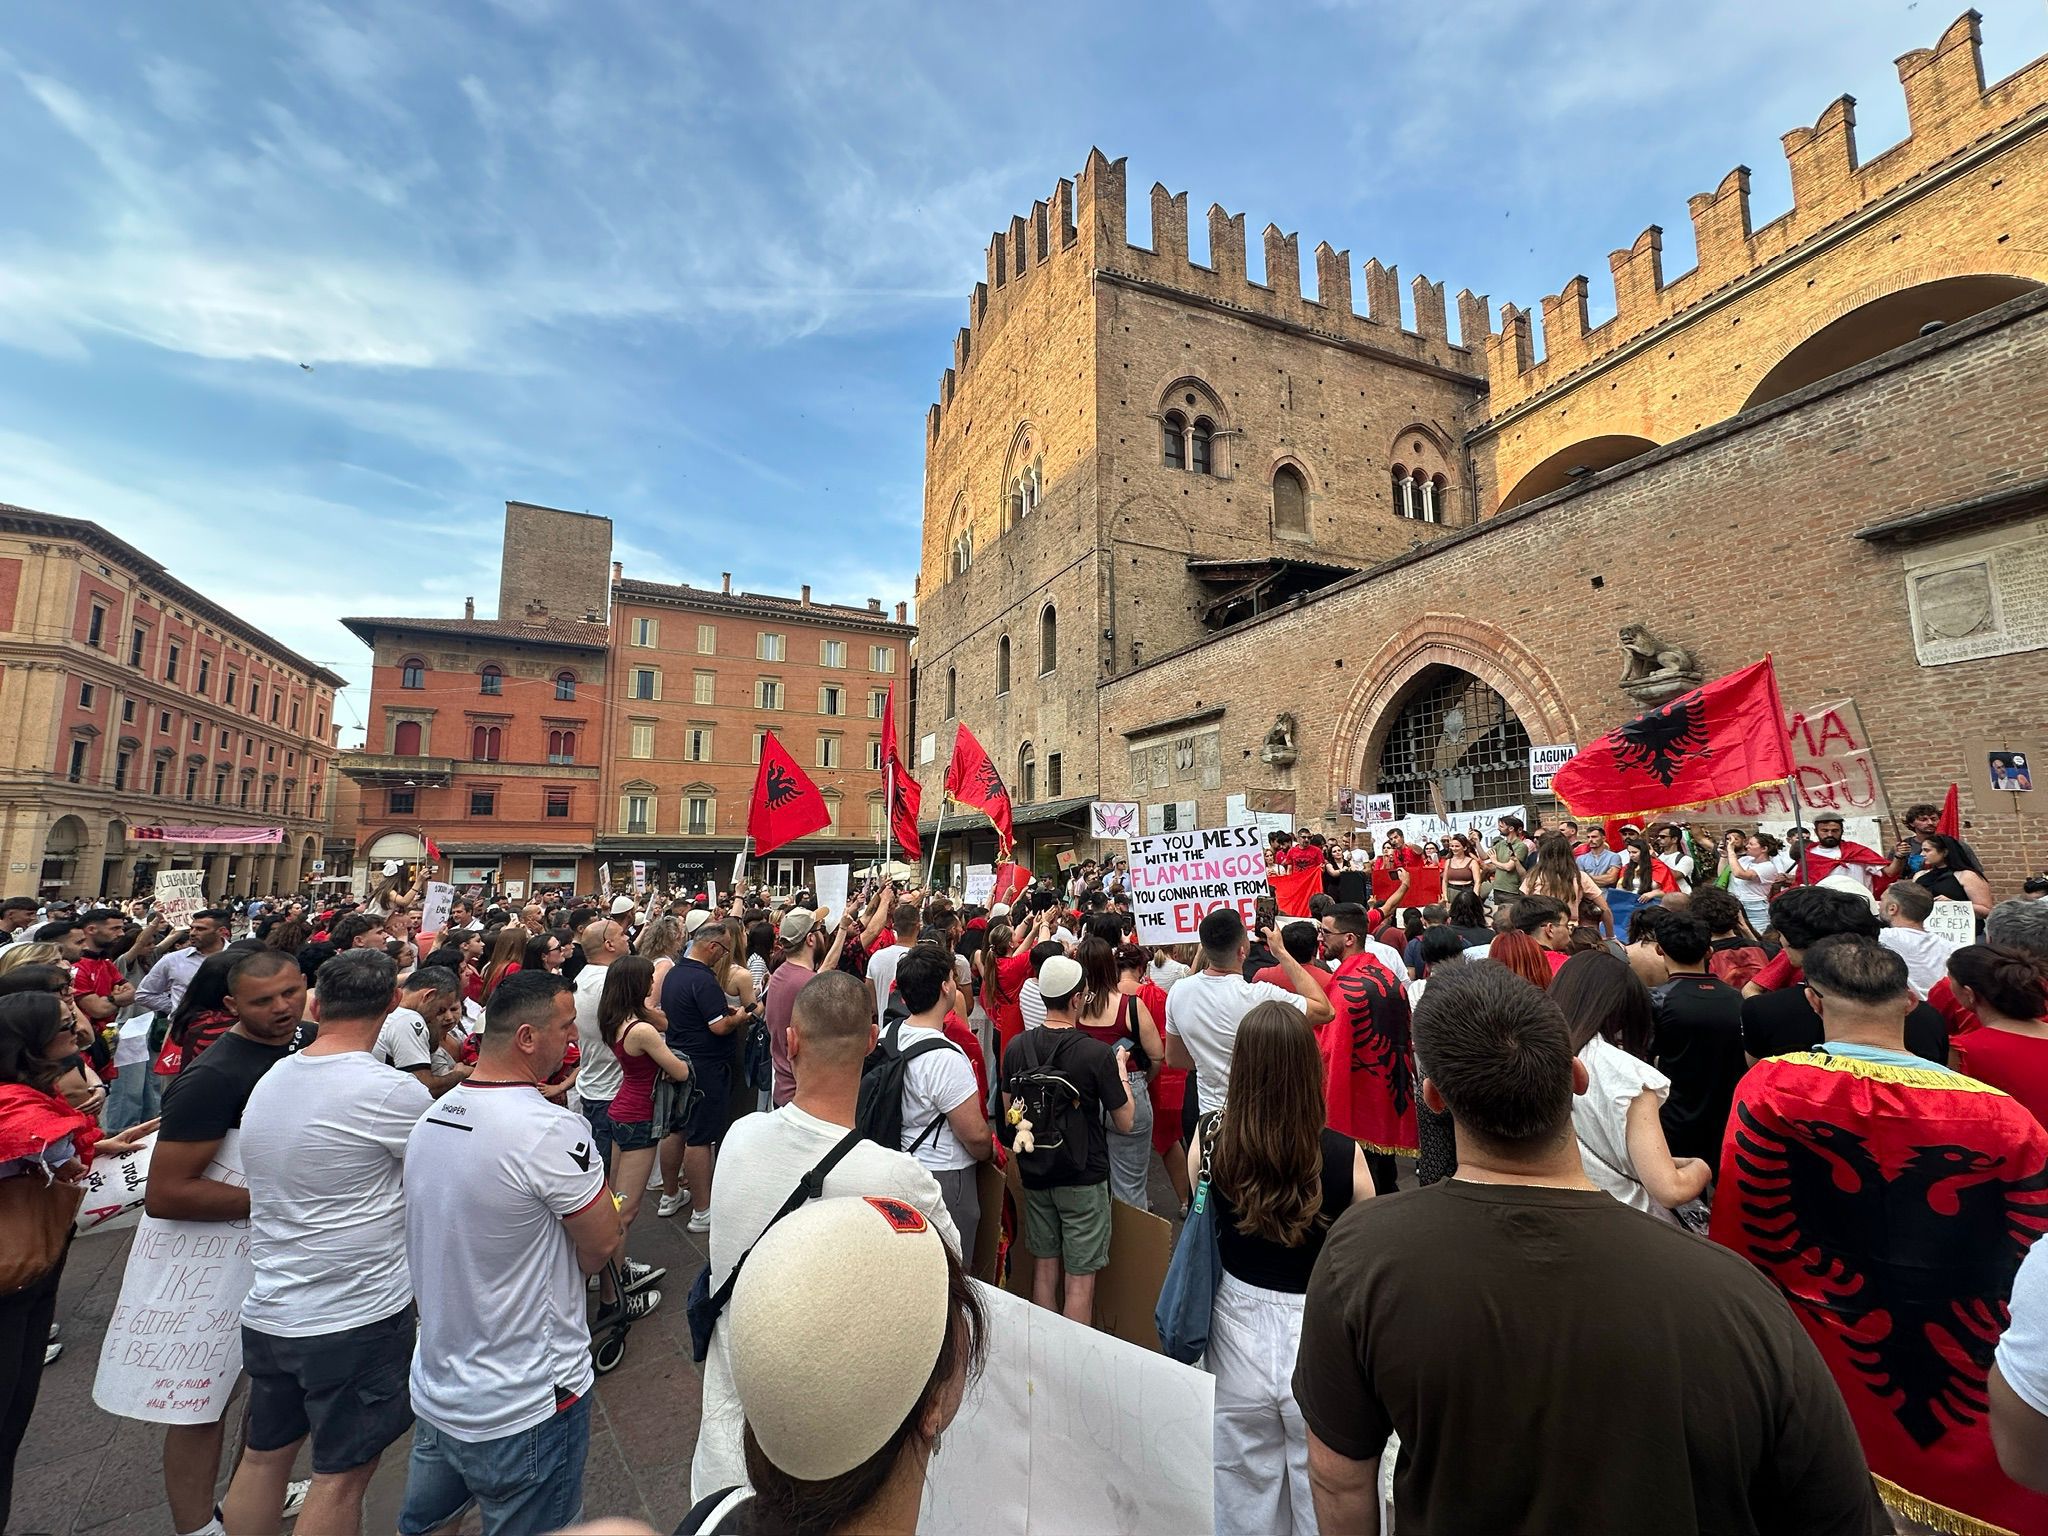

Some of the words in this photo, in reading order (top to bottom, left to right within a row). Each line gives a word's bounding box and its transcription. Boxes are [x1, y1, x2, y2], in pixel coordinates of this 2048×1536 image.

[1534, 749, 1574, 763] LAGUNA
[1131, 840, 1153, 854] IF
[1163, 835, 1193, 851] YOU
[1202, 827, 1259, 850] MESS
[1145, 852, 1179, 865] WITH
[1182, 849, 1205, 861] THE
[1131, 853, 1266, 887] FLAMINGOS
[1134, 890, 1156, 904] YOU
[1158, 886, 1198, 901] GONNA
[1200, 883, 1231, 898] HEAR
[1234, 879, 1269, 895] FROM
[1139, 912, 1166, 927] THE
[1952, 904, 1970, 916] PAR
[135, 1227, 171, 1260] IKE
[171, 1233, 187, 1258] O
[191, 1235, 232, 1259] EDI
